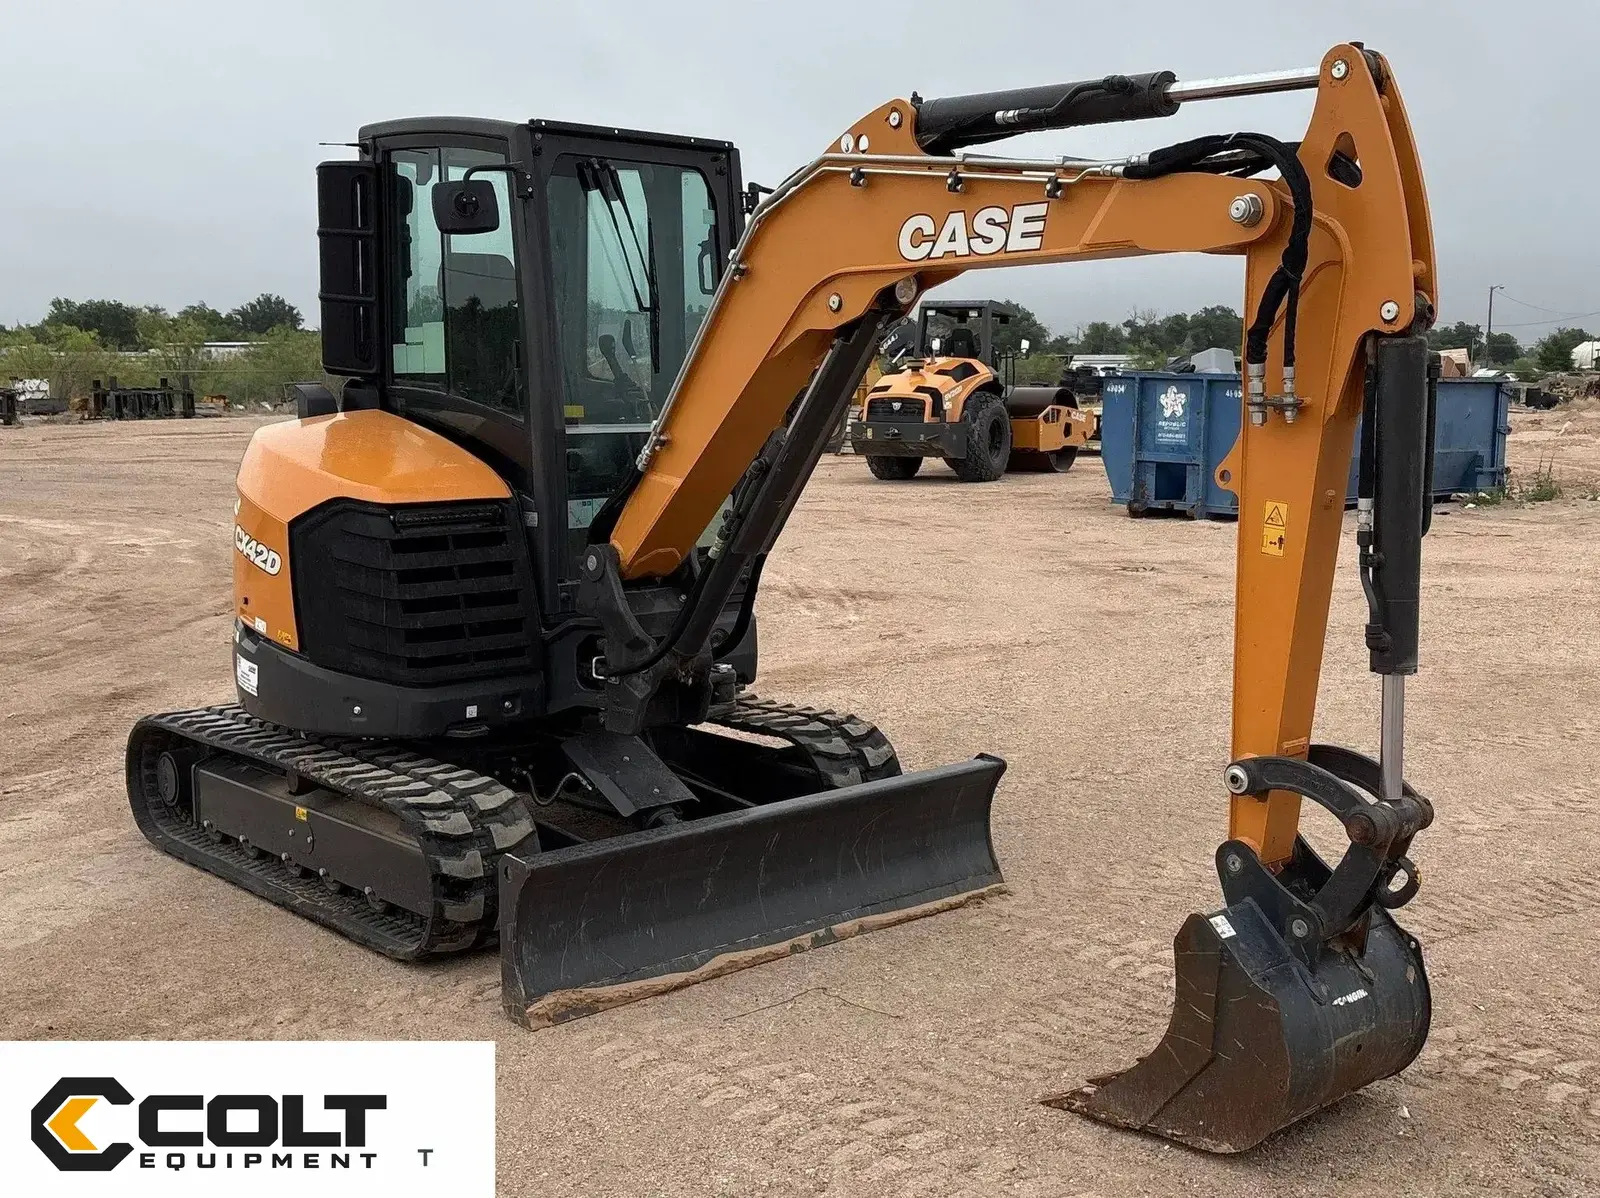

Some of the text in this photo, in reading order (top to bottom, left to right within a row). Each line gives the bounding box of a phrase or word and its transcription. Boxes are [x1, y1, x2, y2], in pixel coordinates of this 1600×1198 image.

[898, 201, 1049, 262] CASE
[1071, 411, 1087, 423] CASE
[235, 524, 283, 577] CX42D
